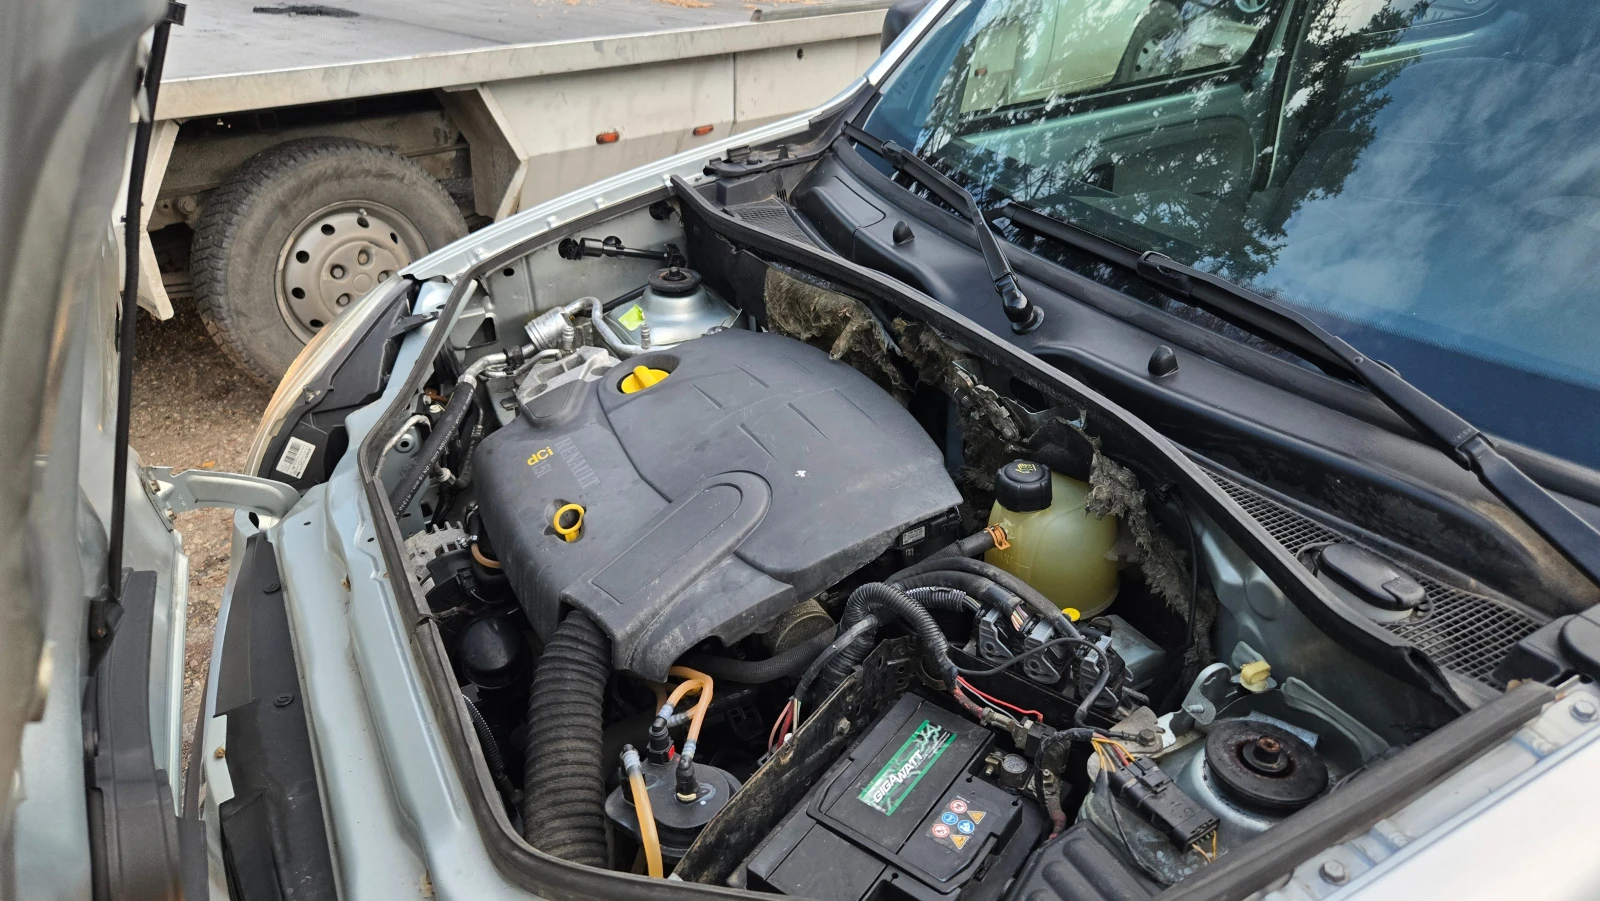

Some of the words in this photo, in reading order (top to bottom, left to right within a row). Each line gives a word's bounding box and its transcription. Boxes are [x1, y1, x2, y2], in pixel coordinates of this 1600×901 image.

[527, 446, 554, 466] dCi
[556, 435, 600, 489] RENAULT
[872, 748, 923, 803] GIGAWATT
